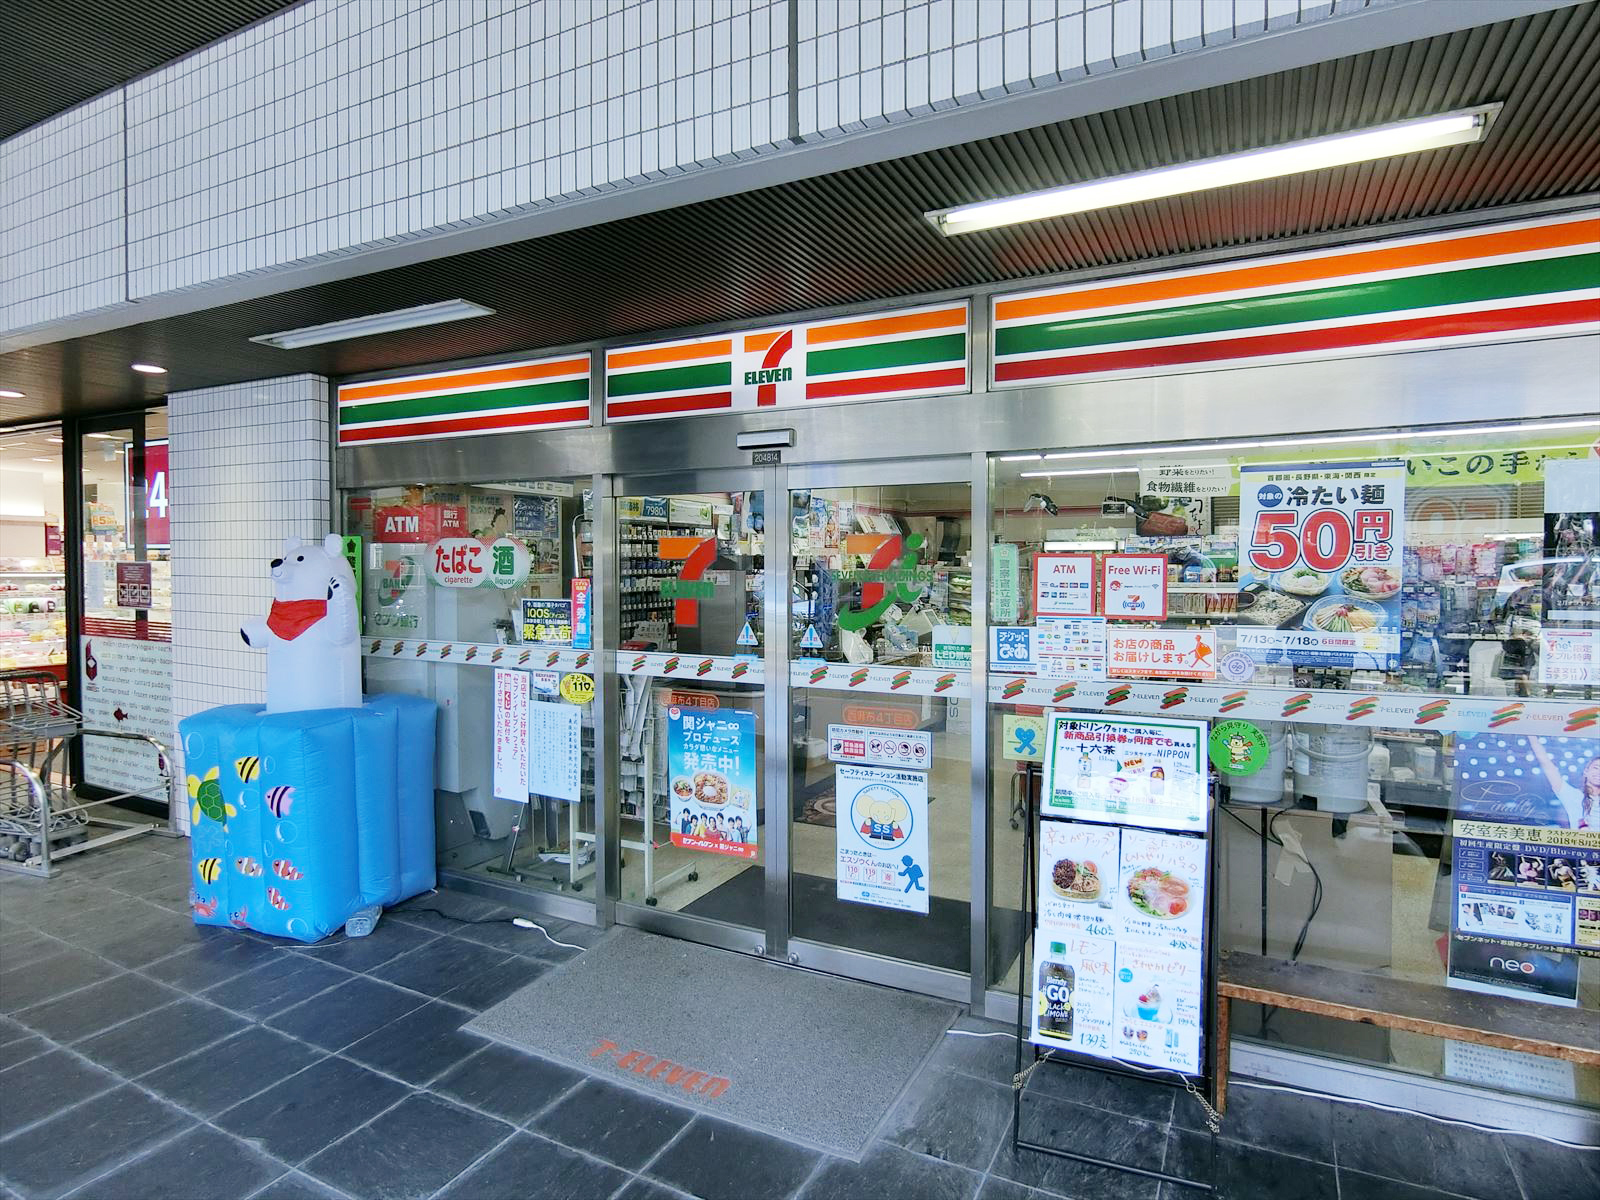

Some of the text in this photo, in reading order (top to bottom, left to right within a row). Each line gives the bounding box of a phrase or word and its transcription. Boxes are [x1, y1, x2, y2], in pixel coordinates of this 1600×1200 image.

[744, 367, 792, 386] ELEVEN
[754, 453, 778, 463] 204814
[1286, 484, 1385, 506] 冷たい麺
[384, 516, 419, 533] ATM
[442, 520, 460, 528] ATM
[1248, 508, 1394, 573] 50 円
[435, 545, 482, 574] たばこ
[1352, 542, 1394, 562] 引き
[492, 545, 515, 576] 酒
[1053, 564, 1076, 574] ATM
[1108, 566, 1160, 575] Free Wi-Fi
[444, 576, 473, 584] cigarette
[495, 576, 515, 586] liquor
[528, 608, 550, 618] IQOS
[524, 624, 572, 640] 緊急入荷
[1000, 632, 1028, 642] チケット
[1000, 643, 1028, 659] ぴあ
[1114, 639, 1175, 650] お店の商品
[1114, 651, 1189, 664] お届けします。
[682, 715, 739, 731] 関ジャニ∞
[1211, 722, 1248, 740] ながら見守り
[682, 732, 740, 746] プロデュース
[1076, 743, 1116, 755] 十六茶
[1157, 749, 1190, 759] NIPPON
[684, 752, 740, 776] 発売中!
[1124, 759, 1142, 767] NEW
[840, 769, 924, 782] セーフティステーション活動実施店
[874, 824, 890, 834] SS
[1460, 823, 1542, 841] 安室奈美恵
[1460, 840, 1520, 851] 初回生産限定盤
[1525, 845, 1587, 858] DVD/Blu-ray
[1070, 939, 1105, 955] レモン
[1081, 958, 1111, 975] 風味
[1490, 956, 1535, 974] neo
[1047, 984, 1070, 1003] GO
